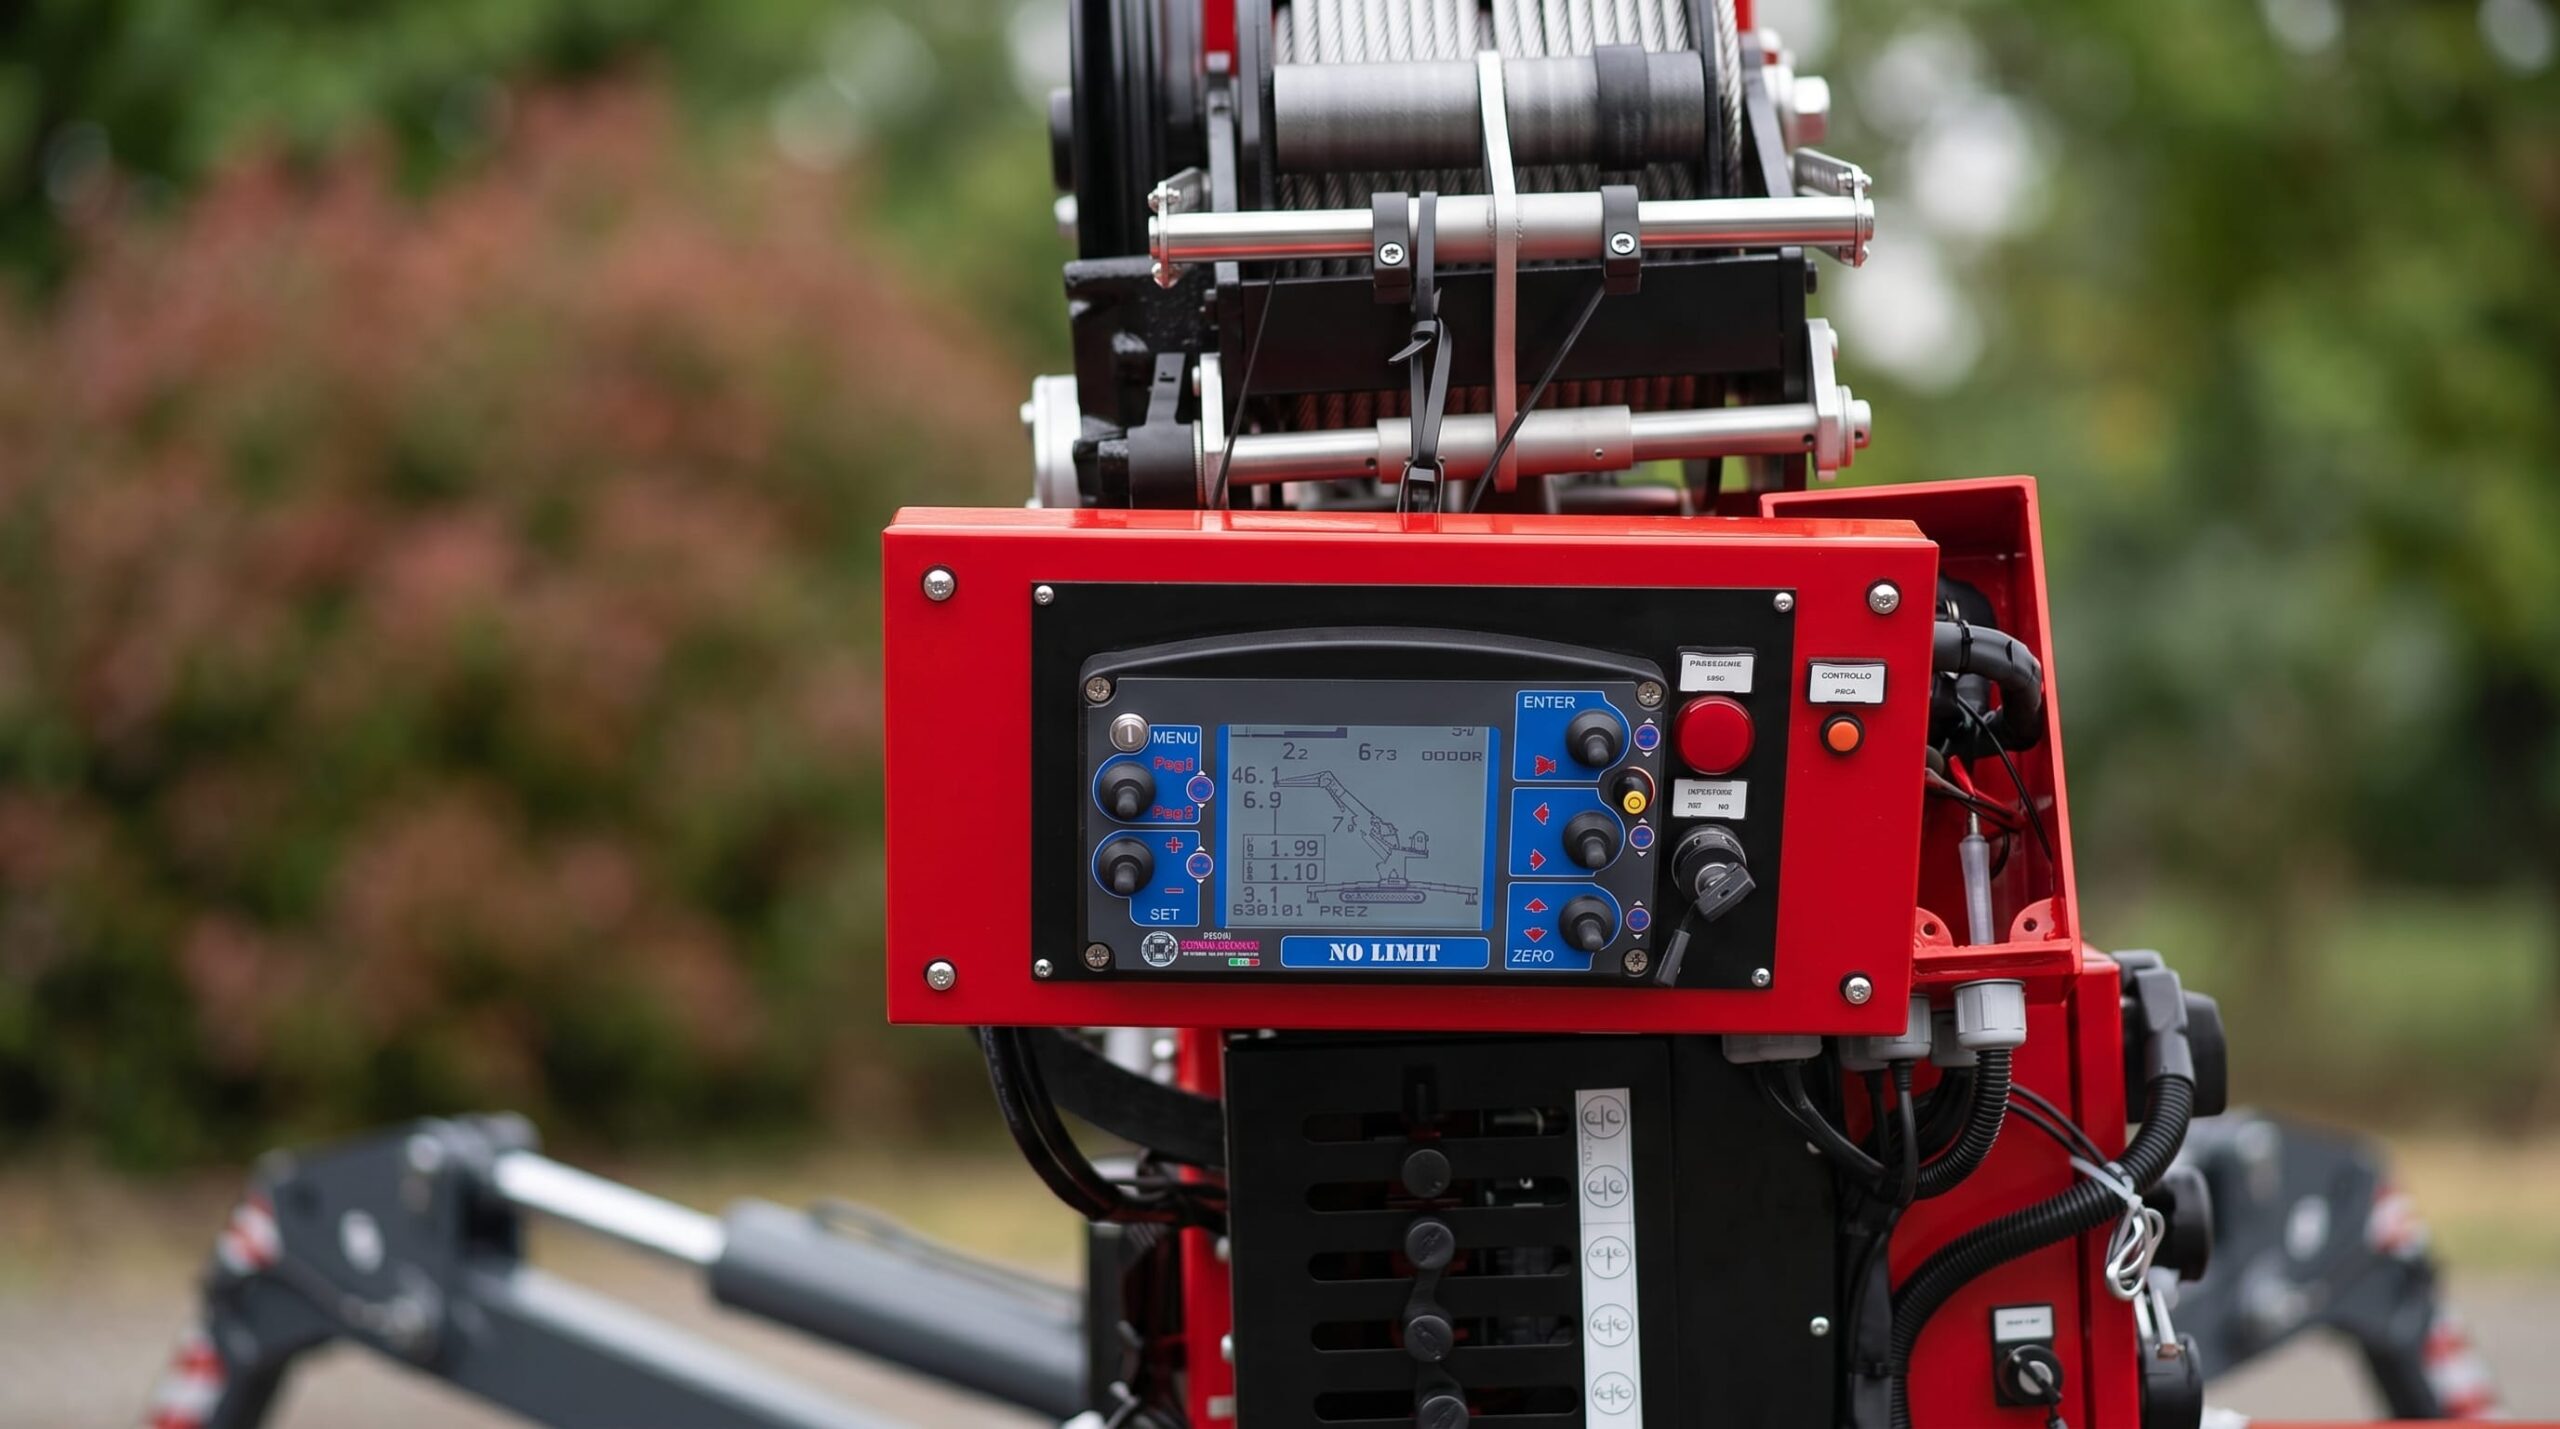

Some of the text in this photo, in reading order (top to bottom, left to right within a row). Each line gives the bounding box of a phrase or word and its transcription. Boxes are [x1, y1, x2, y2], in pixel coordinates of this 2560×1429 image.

[1821, 672, 1872, 680] CONTROLLO
[1523, 696, 1576, 709] ENTER
[1153, 731, 1198, 744] MENU
[1231, 766, 1281, 784] 46.1
[1243, 791, 1282, 809] 6.9
[1270, 839, 1319, 857] 1.99
[1270, 863, 1318, 881] 1.10
[1243, 886, 1280, 903] 3.1
[1149, 908, 1180, 921] SET
[1319, 905, 1369, 918] PREZ
[1329, 943, 1441, 962] NO LIMIT
[1511, 949, 1555, 963] ZERO
